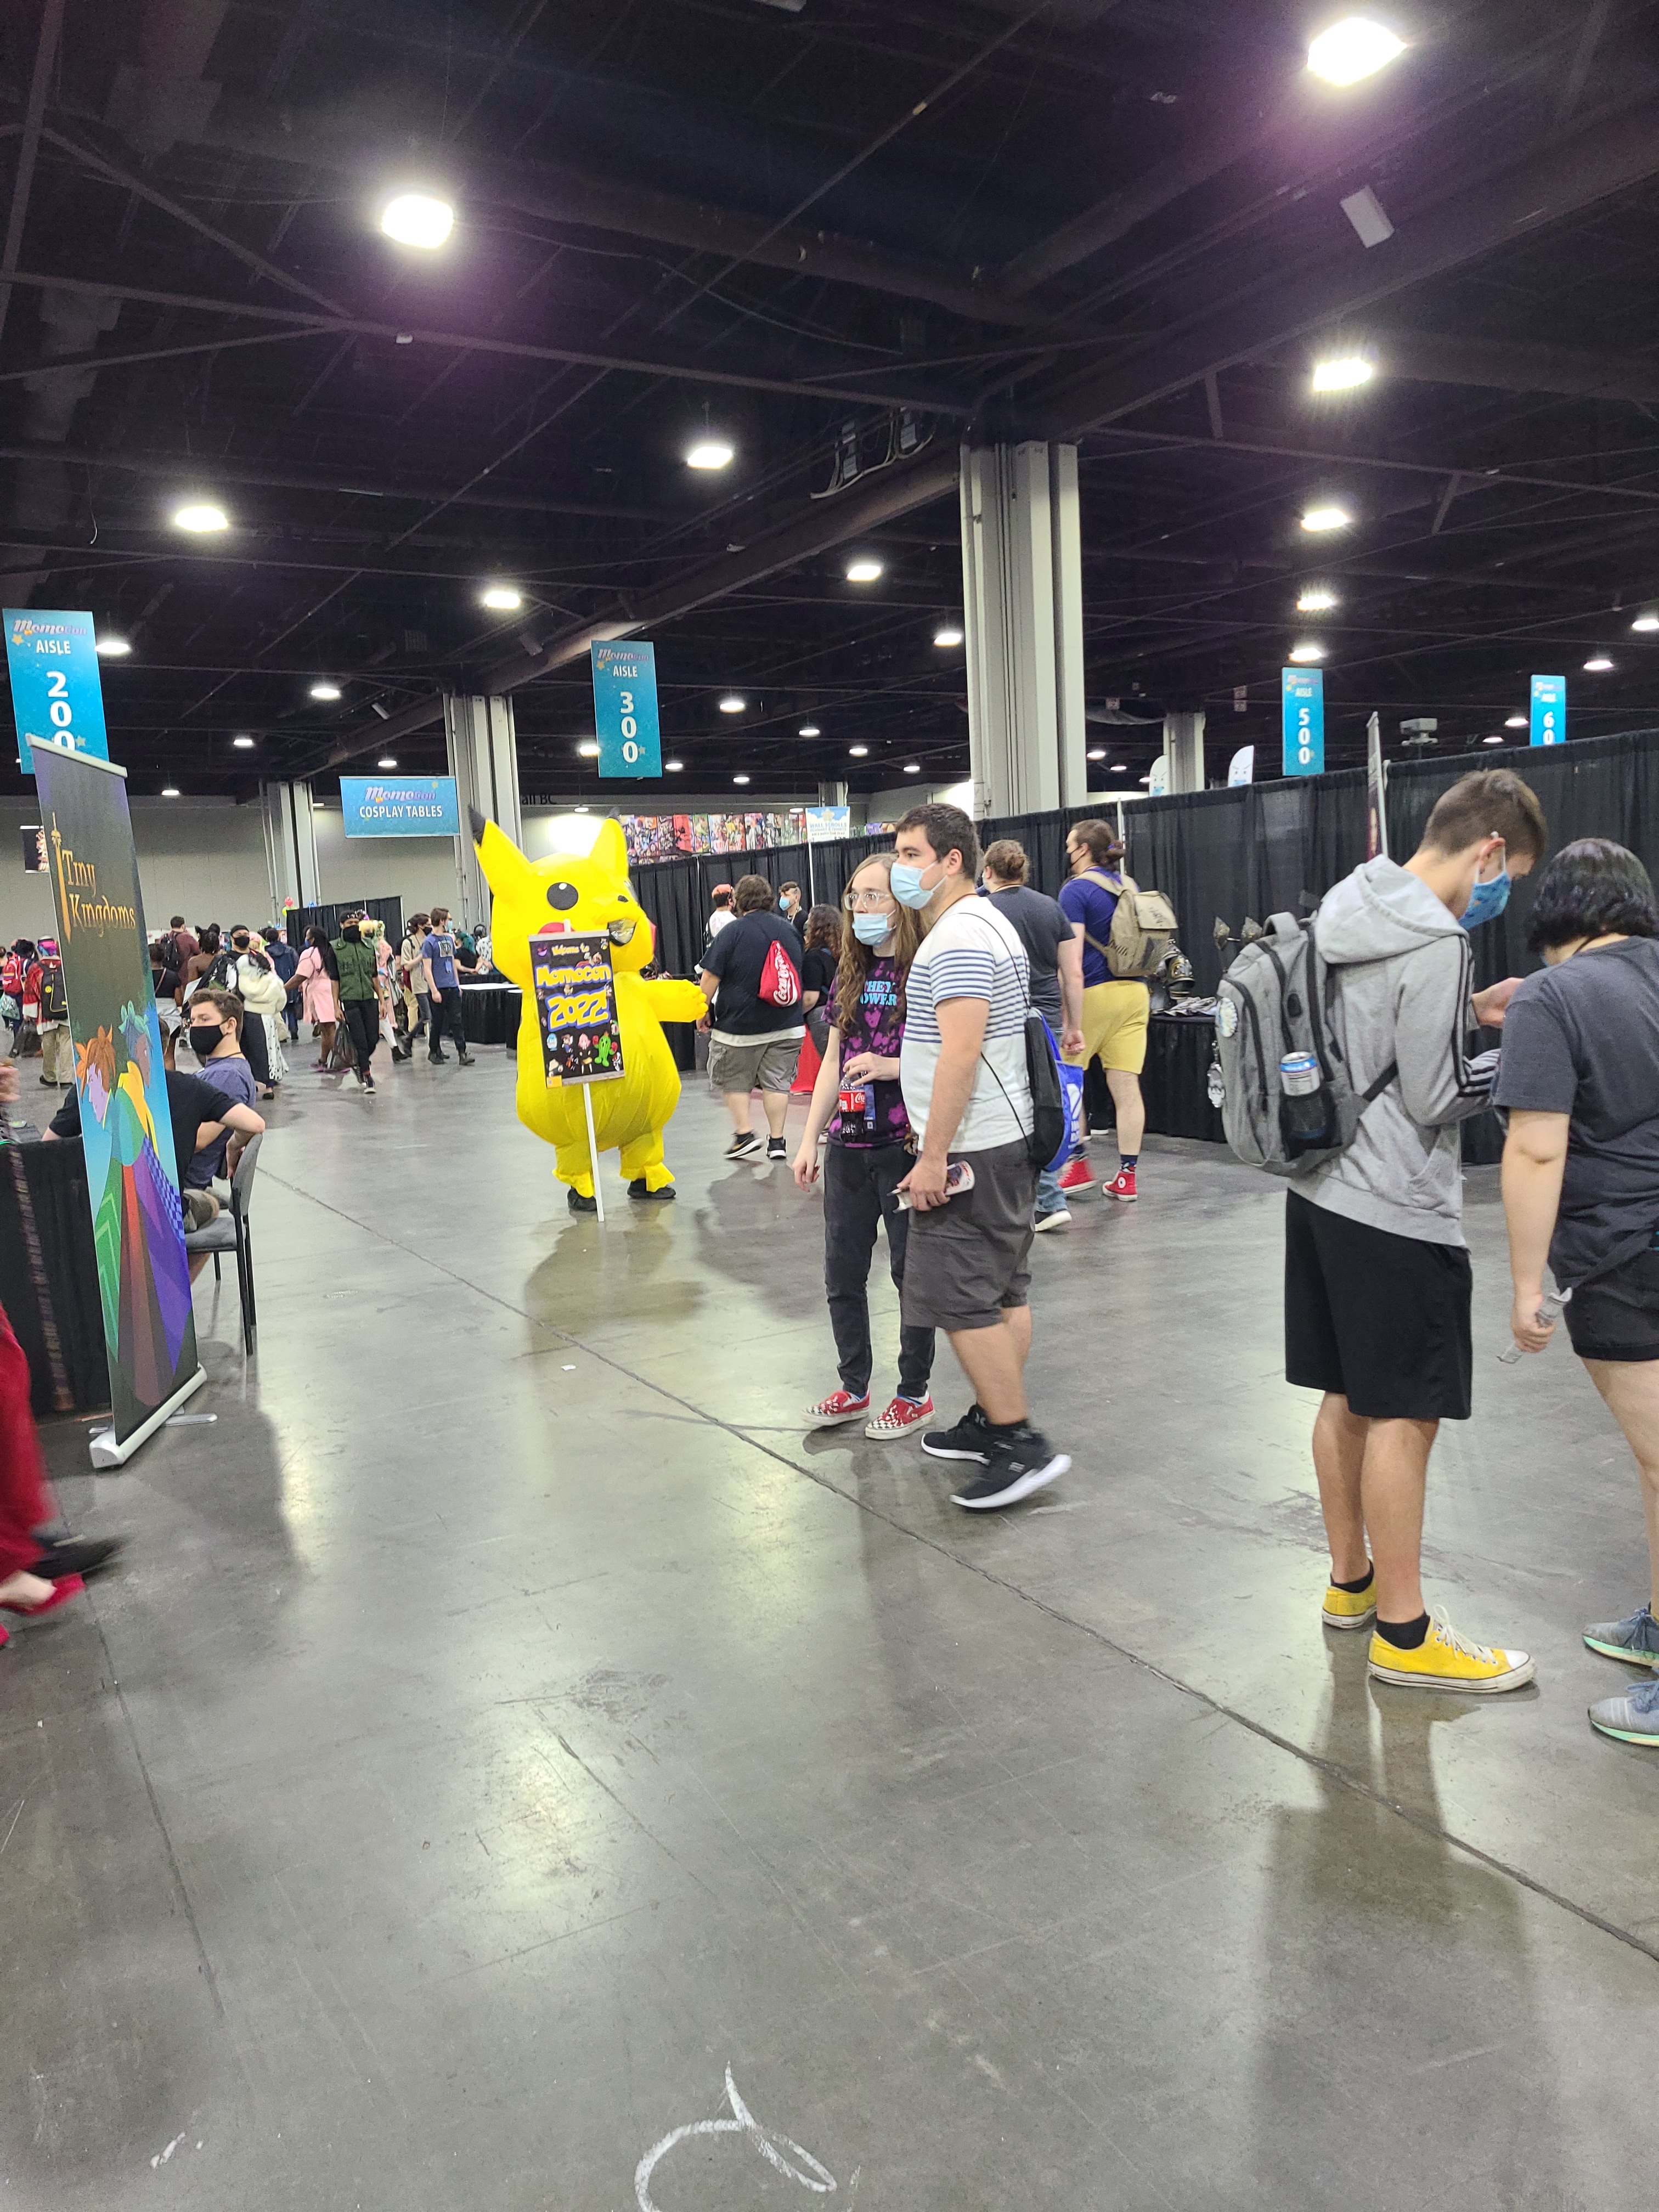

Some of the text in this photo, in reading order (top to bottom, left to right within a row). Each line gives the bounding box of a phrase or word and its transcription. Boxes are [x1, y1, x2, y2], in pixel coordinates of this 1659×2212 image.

[36, 639, 71, 654] AISLE
[613, 665, 638, 678] AISLE
[619, 691, 639, 763] 300
[1297, 708, 1311, 764] 500
[359, 805, 443, 819] COSPLAY TABLES
[62, 849, 97, 898] Tiny
[69, 893, 136, 938] Kingdoms
